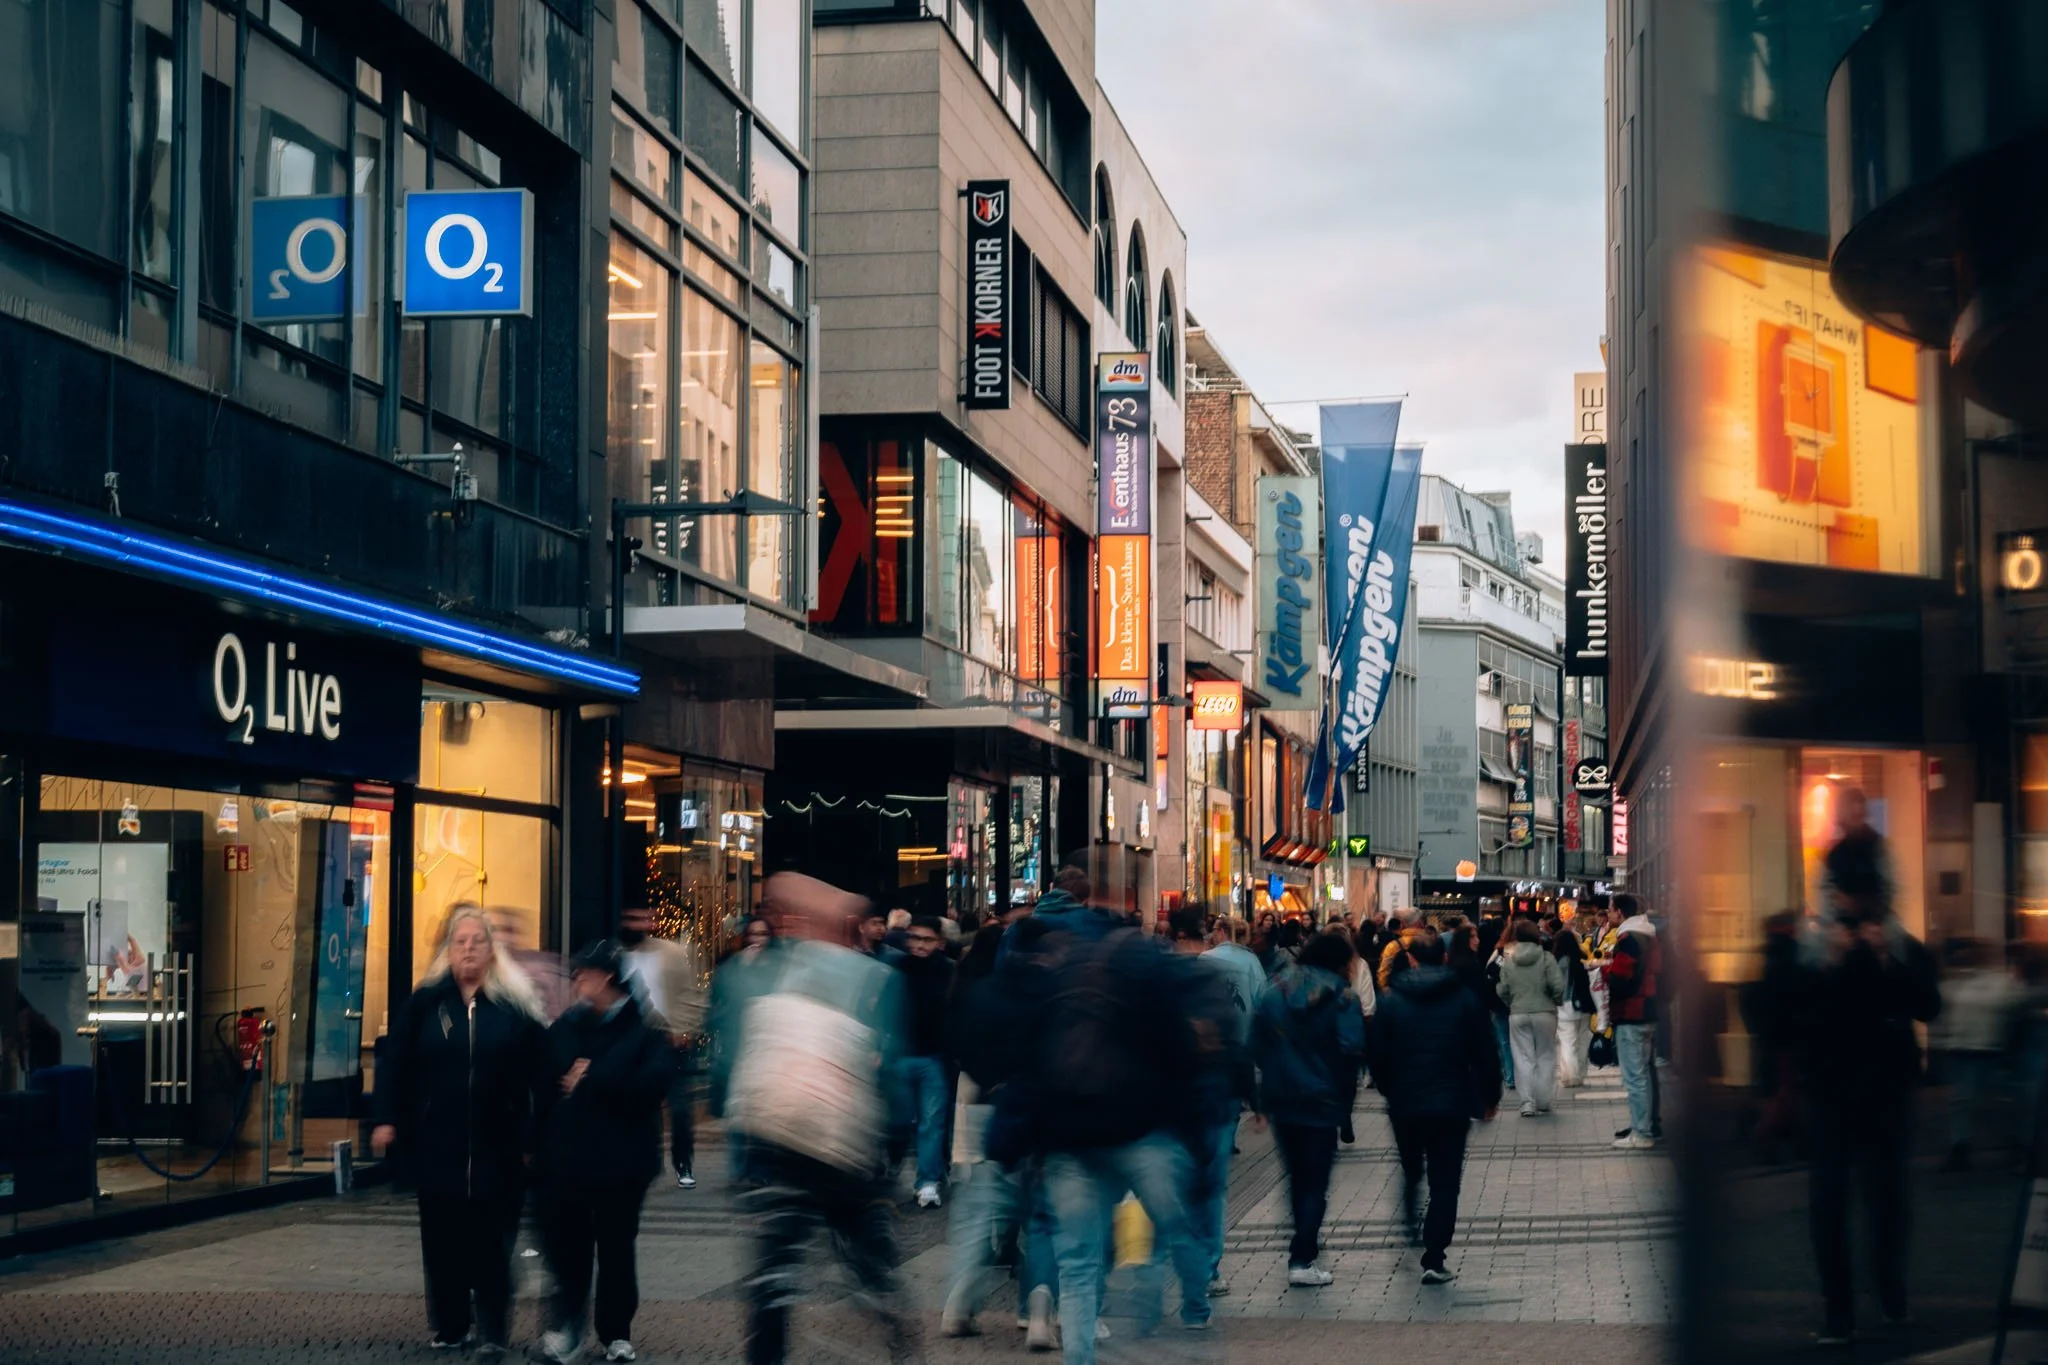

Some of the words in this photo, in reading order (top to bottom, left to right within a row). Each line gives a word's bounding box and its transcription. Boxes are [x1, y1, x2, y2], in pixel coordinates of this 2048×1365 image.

[974, 344, 1002, 398] FOOT
[1113, 360, 1139, 374] dm
[1108, 397, 1138, 431] 73
[1110, 432, 1130, 529] Eventhaus
[1576, 462, 1607, 658] hunkemöller
[1265, 490, 1313, 697] Kämpgen
[1120, 649, 1133, 672] Das
[1341, 550, 1397, 751] Kämpgen
[266, 641, 342, 741] Live
[1112, 686, 1138, 703] dm
[1197, 695, 1238, 714] LEGO
[1357, 743, 1367, 790] BUCKS
[1566, 791, 1579, 851] EUROPA
